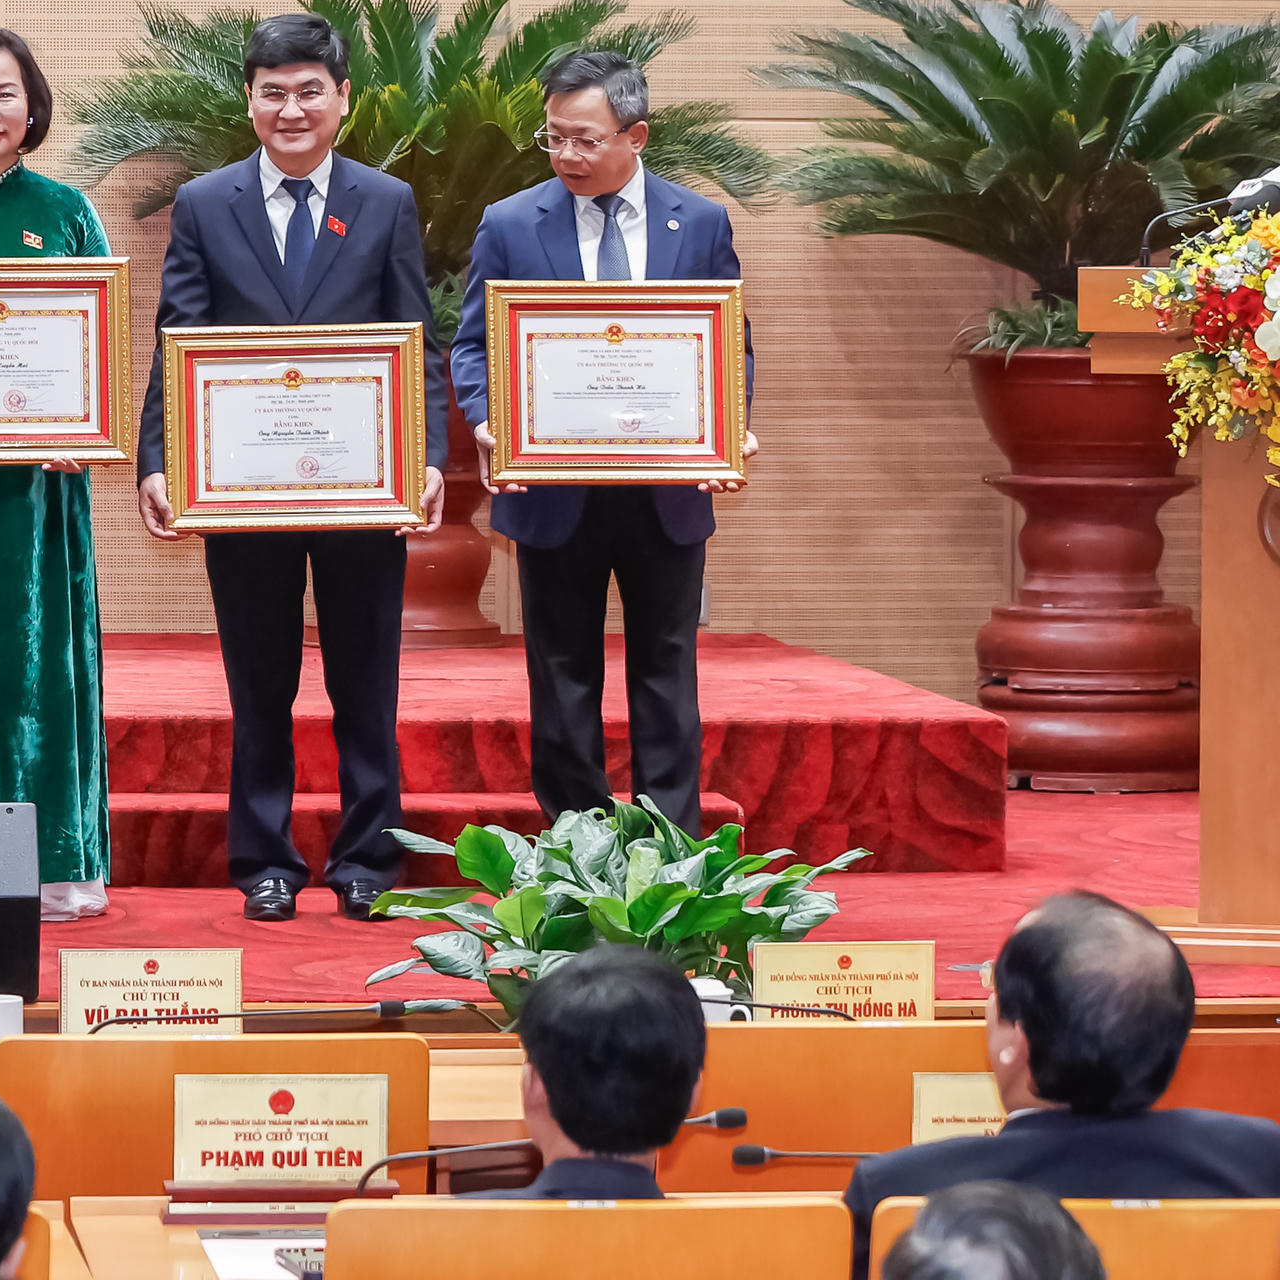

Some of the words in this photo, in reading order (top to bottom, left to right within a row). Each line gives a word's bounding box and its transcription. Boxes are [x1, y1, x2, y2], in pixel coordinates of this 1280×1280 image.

[122, 990, 148, 1002] CHỦ
[150, 992, 180, 1004] TỊCH
[816, 984, 841, 996] CHỦ
[844, 986, 872, 998] TỊCH
[84, 1005, 109, 1026] VŨ
[153, 1001, 219, 1026] THẮNG
[897, 998, 917, 1018] HÀ
[234, 1130, 262, 1142] PHÓ
[266, 1128, 293, 1142] CHỦ
[296, 1132, 329, 1144] TỊCH
[200, 1150, 264, 1171] PHẠM
[272, 1147, 308, 1170] QUÍ
[314, 1146, 363, 1167] TIÊN
